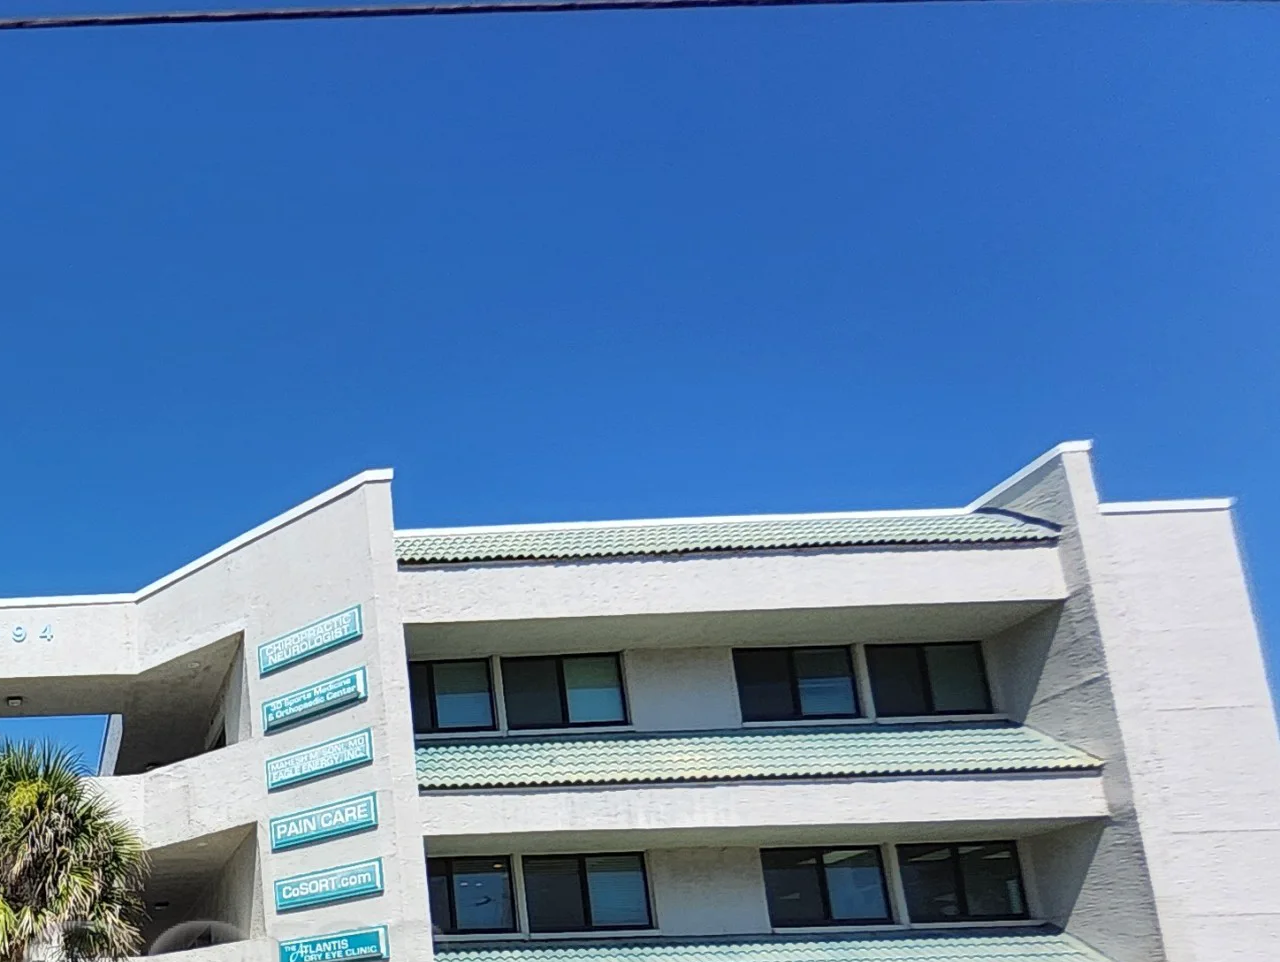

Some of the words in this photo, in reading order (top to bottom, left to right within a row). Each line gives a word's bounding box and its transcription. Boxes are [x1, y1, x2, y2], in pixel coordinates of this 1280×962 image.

[265, 614, 352, 656] CHIROPRACTIC
[267, 624, 351, 665] NEUROLOGIST
[313, 677, 352, 696] Medicine
[326, 685, 356, 701] Center
[276, 816, 317, 840] PAIN
[320, 803, 369, 828] CARE
[282, 872, 372, 899] CoSORT.com
[290, 939, 349, 962] ATLANTIS
[303, 952, 322, 962] DRY
[325, 950, 343, 960] EYE
[345, 945, 378, 957] CLINIC
